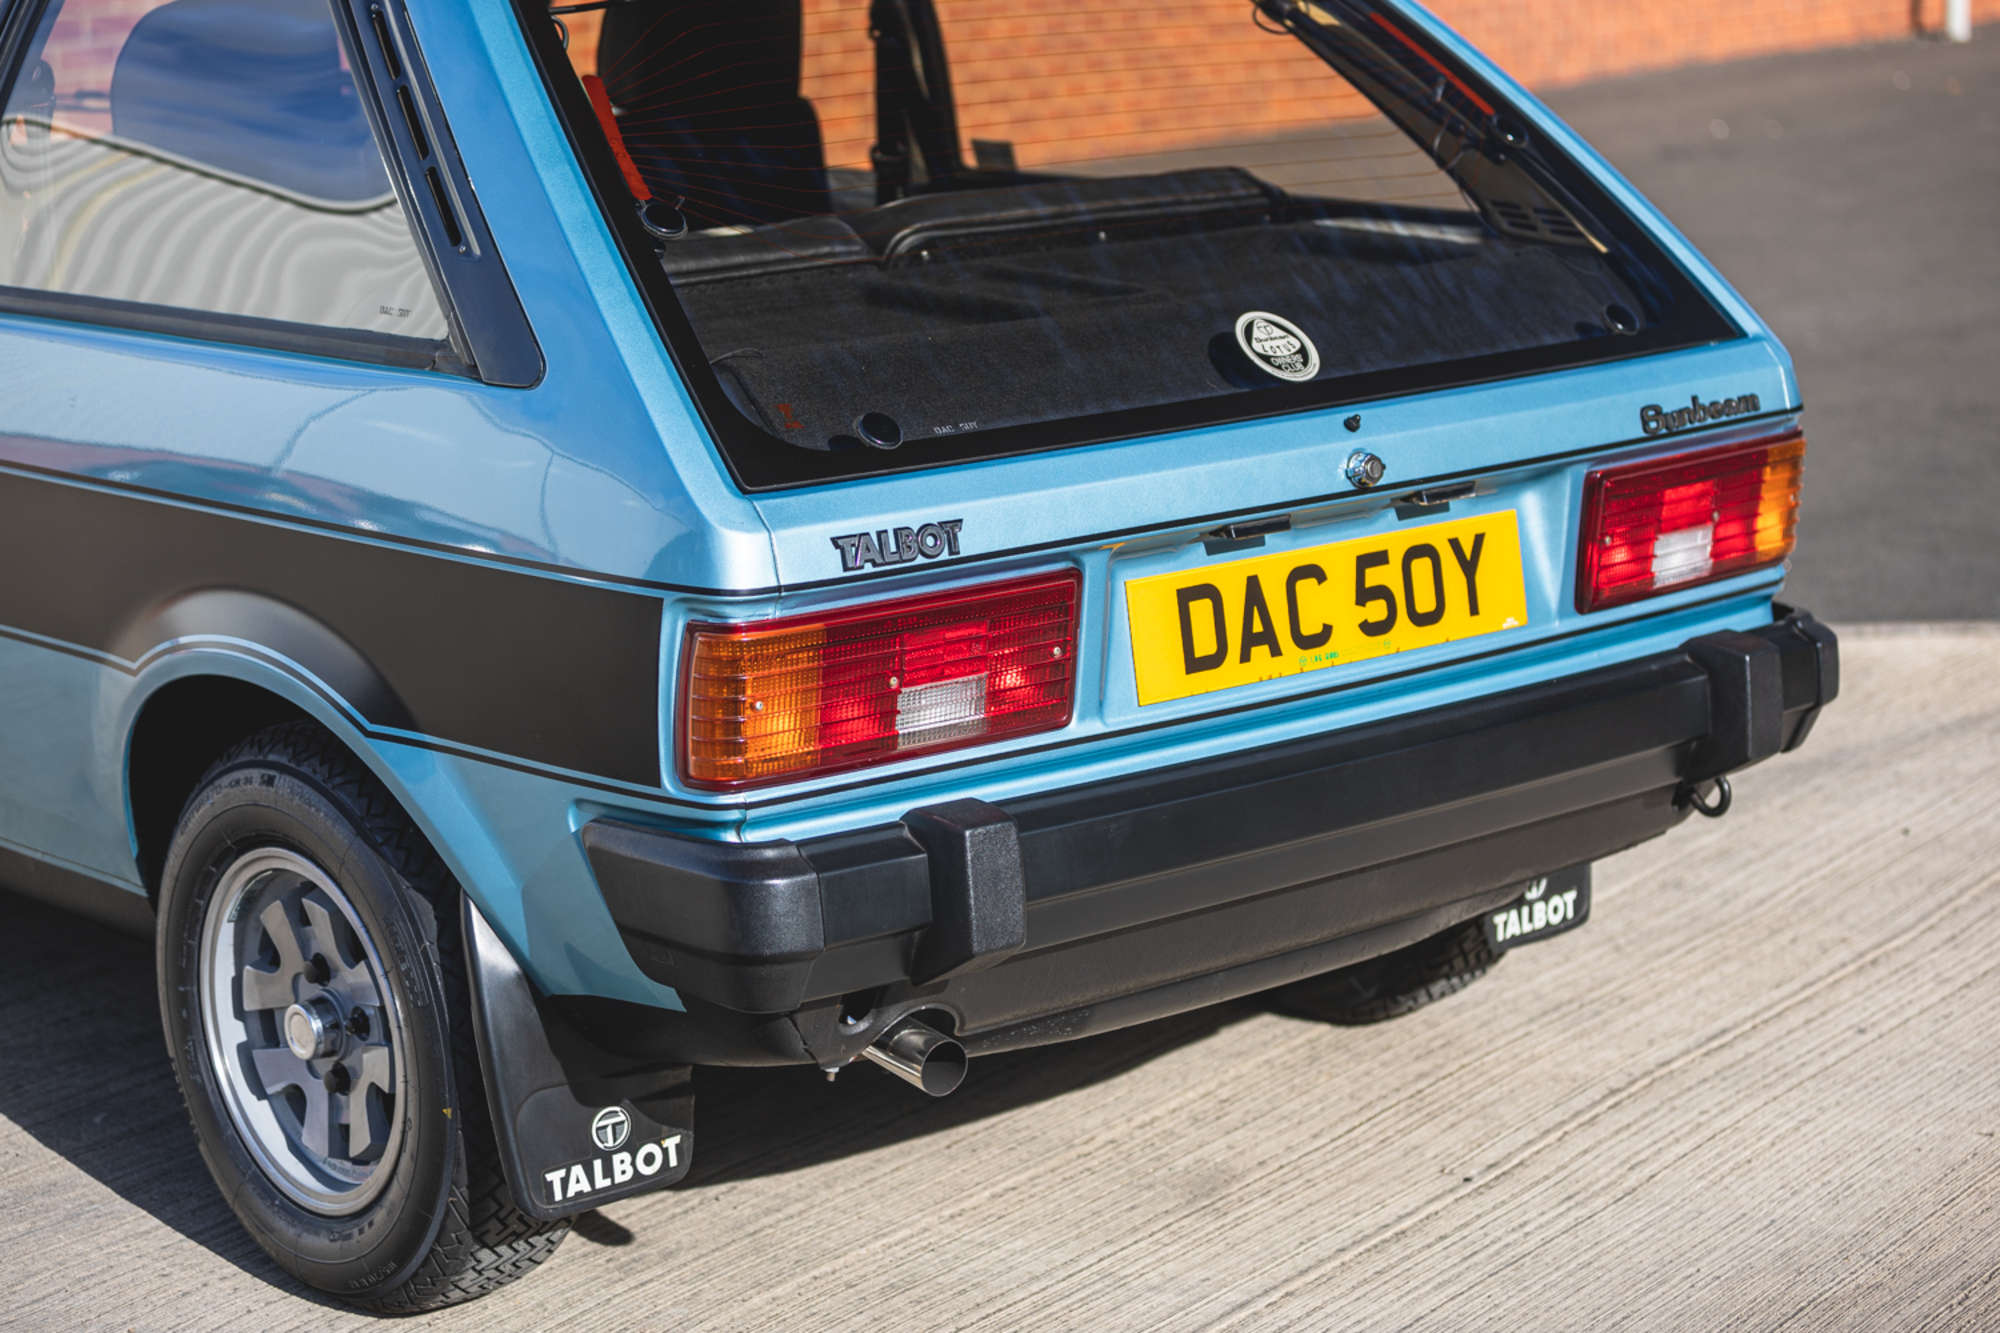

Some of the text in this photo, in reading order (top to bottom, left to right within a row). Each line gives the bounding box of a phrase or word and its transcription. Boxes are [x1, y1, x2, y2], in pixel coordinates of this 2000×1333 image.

[1261, 341, 1297, 354] LOTUS
[1640, 393, 1761, 435] Sunbeam
[830, 519, 963, 572] TALBOT
[1176, 532, 1485, 675] DAC 50Y
[1493, 888, 1577, 943] TALBOT
[544, 1134, 682, 1202] TALBOT
